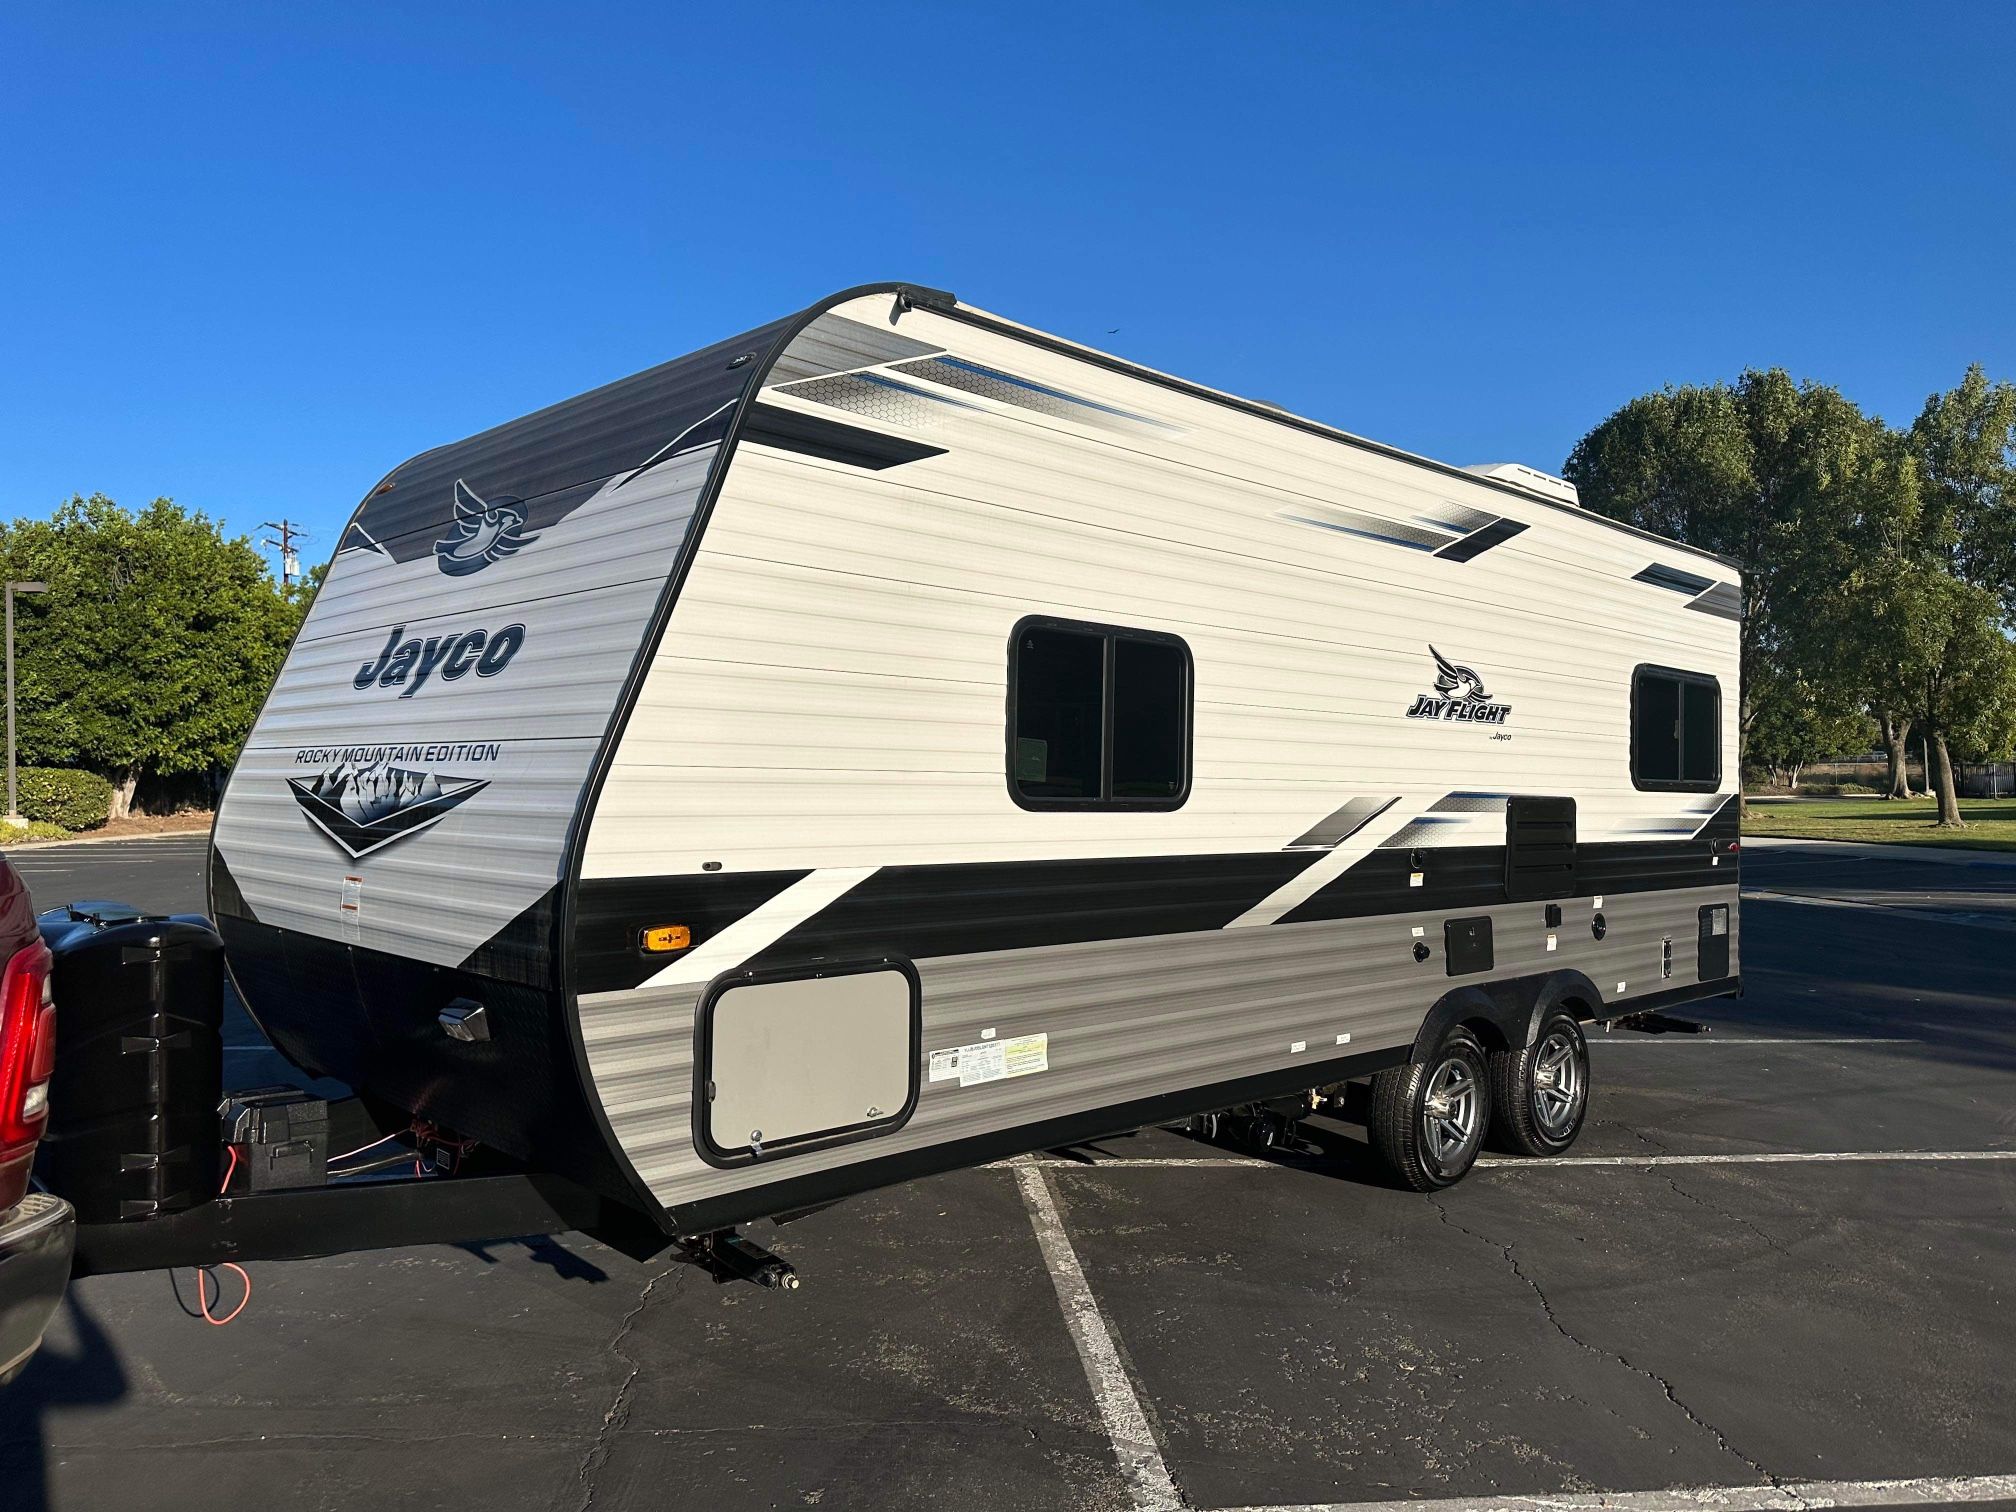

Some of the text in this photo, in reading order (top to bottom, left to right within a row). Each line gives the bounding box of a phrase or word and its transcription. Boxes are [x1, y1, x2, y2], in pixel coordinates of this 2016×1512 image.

[353, 623, 526, 699] Jayco
[1406, 694, 1512, 724] JAY FLIGHT
[1492, 732, 1512, 741] Jayco
[295, 744, 502, 764] ROCKY MOUNTAIN EDITION
